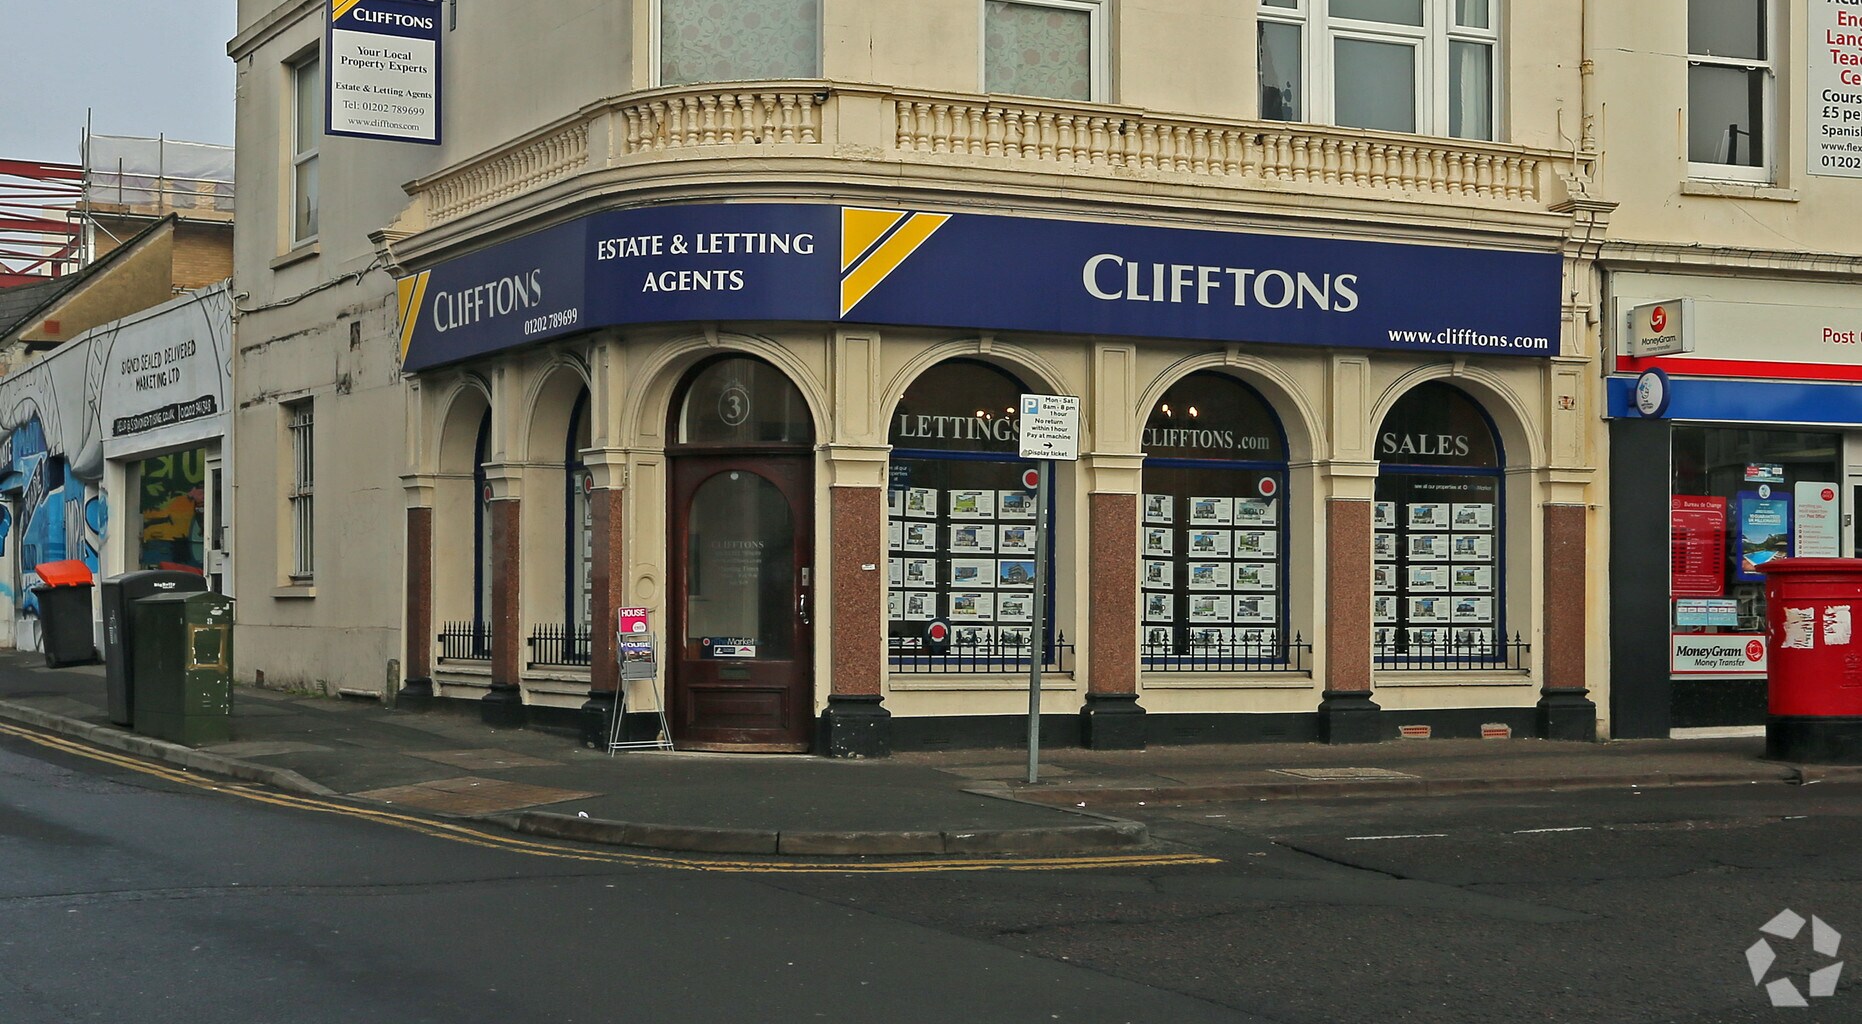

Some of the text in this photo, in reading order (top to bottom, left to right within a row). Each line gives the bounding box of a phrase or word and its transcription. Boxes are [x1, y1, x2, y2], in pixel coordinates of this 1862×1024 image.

[352, 7, 433, 29] CLIFFTONS
[357, 46, 412, 61] Your Local
[1830, 49, 1862, 66] Tea
[341, 55, 427, 74] Property Experts
[335, 81, 432, 99] Estate & Letting Agents
[343, 100, 425, 116] Tel: 01202 789699
[1822, 106, 1862, 123] £5 pe
[348, 118, 420, 131] www.clifftons.com
[1821, 124, 1862, 137] Spanis
[1821, 155, 1861, 169] 01202
[597, 233, 814, 261] ESTATE & LETTING
[642, 270, 744, 292] AGENTS
[1082, 253, 1359, 313] CLIFFTONS
[433, 268, 542, 333] CLIFFTONS
[524, 307, 578, 335] 01202 789699
[1388, 328, 1548, 349] www.clifftons.com
[1641, 335, 1676, 347] MoneyGram
[1823, 327, 1855, 344] Post
[121, 339, 196, 375] SIGNED SEALED DELIVERED
[136, 367, 181, 391] MARKETING LTD
[727, 395, 741, 419] 3
[1142, 428, 1270, 449] CLIFFTONS .com
[1382, 432, 1469, 457] SALES
[621, 609, 645, 617] HOUSE
[1676, 645, 1742, 658] MoneyGram
[1694, 658, 1745, 668] Money Transfer
